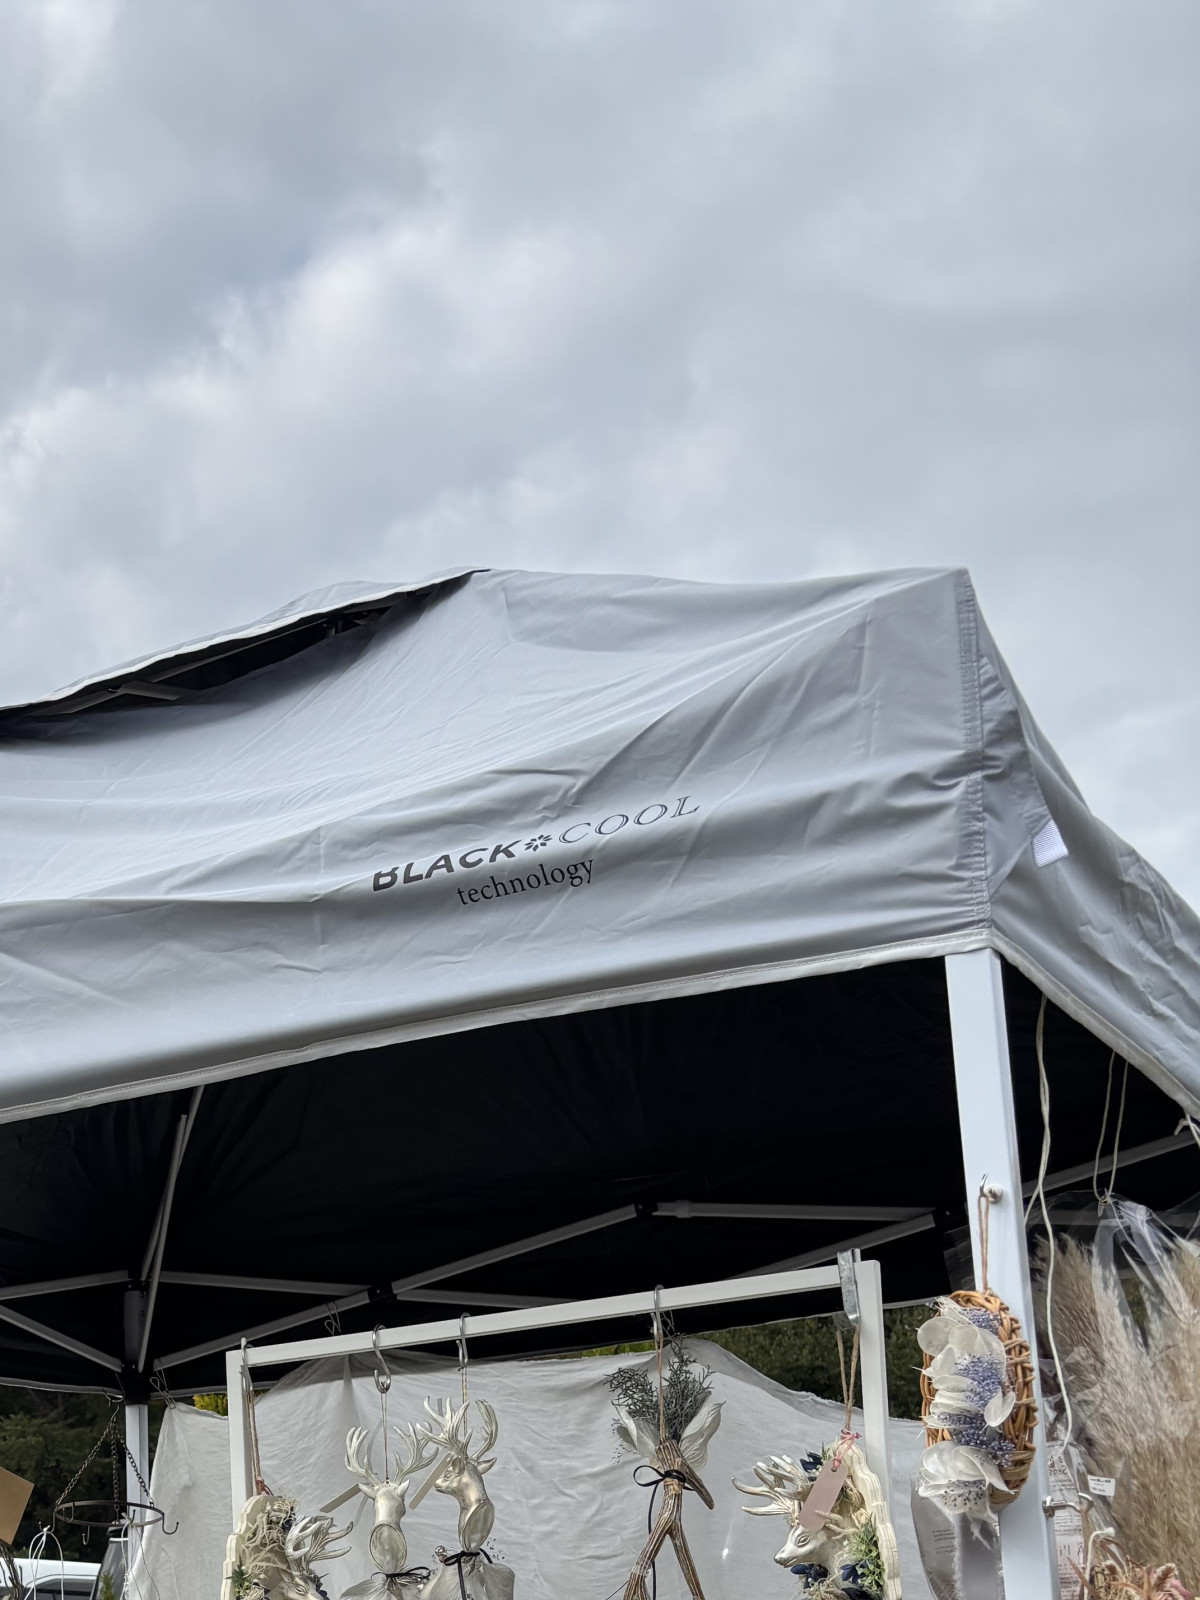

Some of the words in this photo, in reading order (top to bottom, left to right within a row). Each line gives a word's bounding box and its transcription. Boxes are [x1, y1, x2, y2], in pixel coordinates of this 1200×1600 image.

[372, 839, 522, 892] BLACK
[558, 795, 700, 844] COOL
[456, 859, 594, 905] technology
